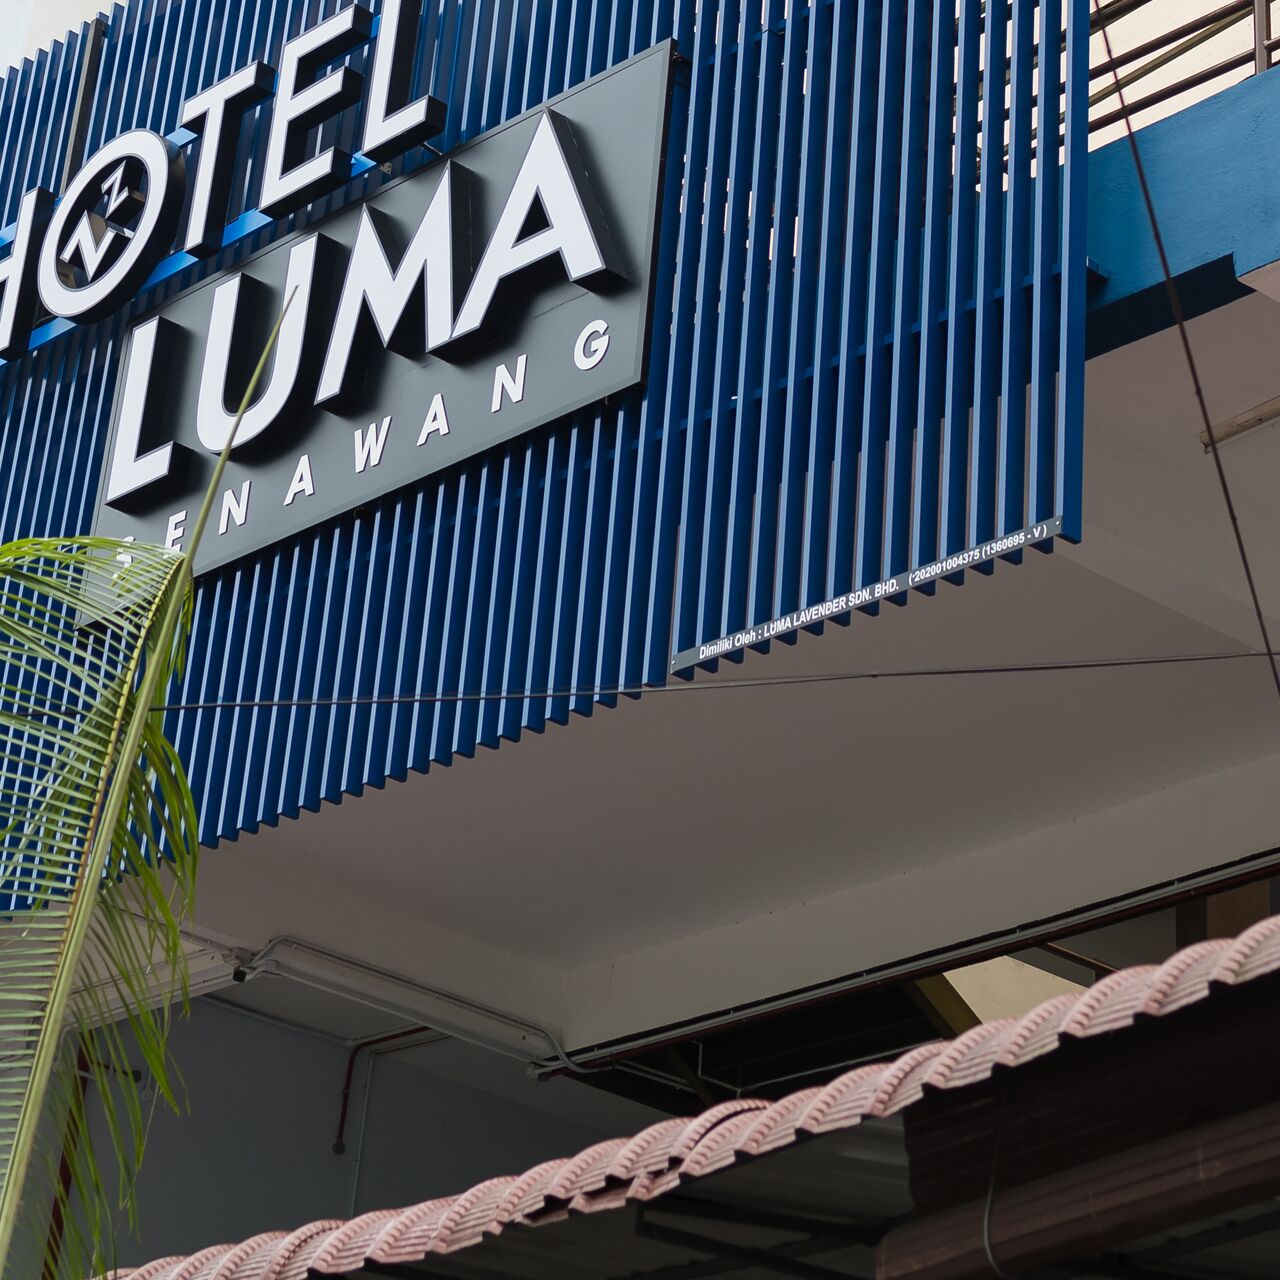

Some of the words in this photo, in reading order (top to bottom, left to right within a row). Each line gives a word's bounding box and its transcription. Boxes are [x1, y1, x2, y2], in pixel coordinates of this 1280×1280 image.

[106, 112, 604, 505] LUMA
[699, 637, 733, 660] Dimiliki
[735, 630, 756, 647] Oleh
[763, 618, 792, 638] LUMA
[793, 596, 847, 627] LAVENDER
[848, 587, 872, 608] SDN.
[874, 578, 899, 598] BHD.
